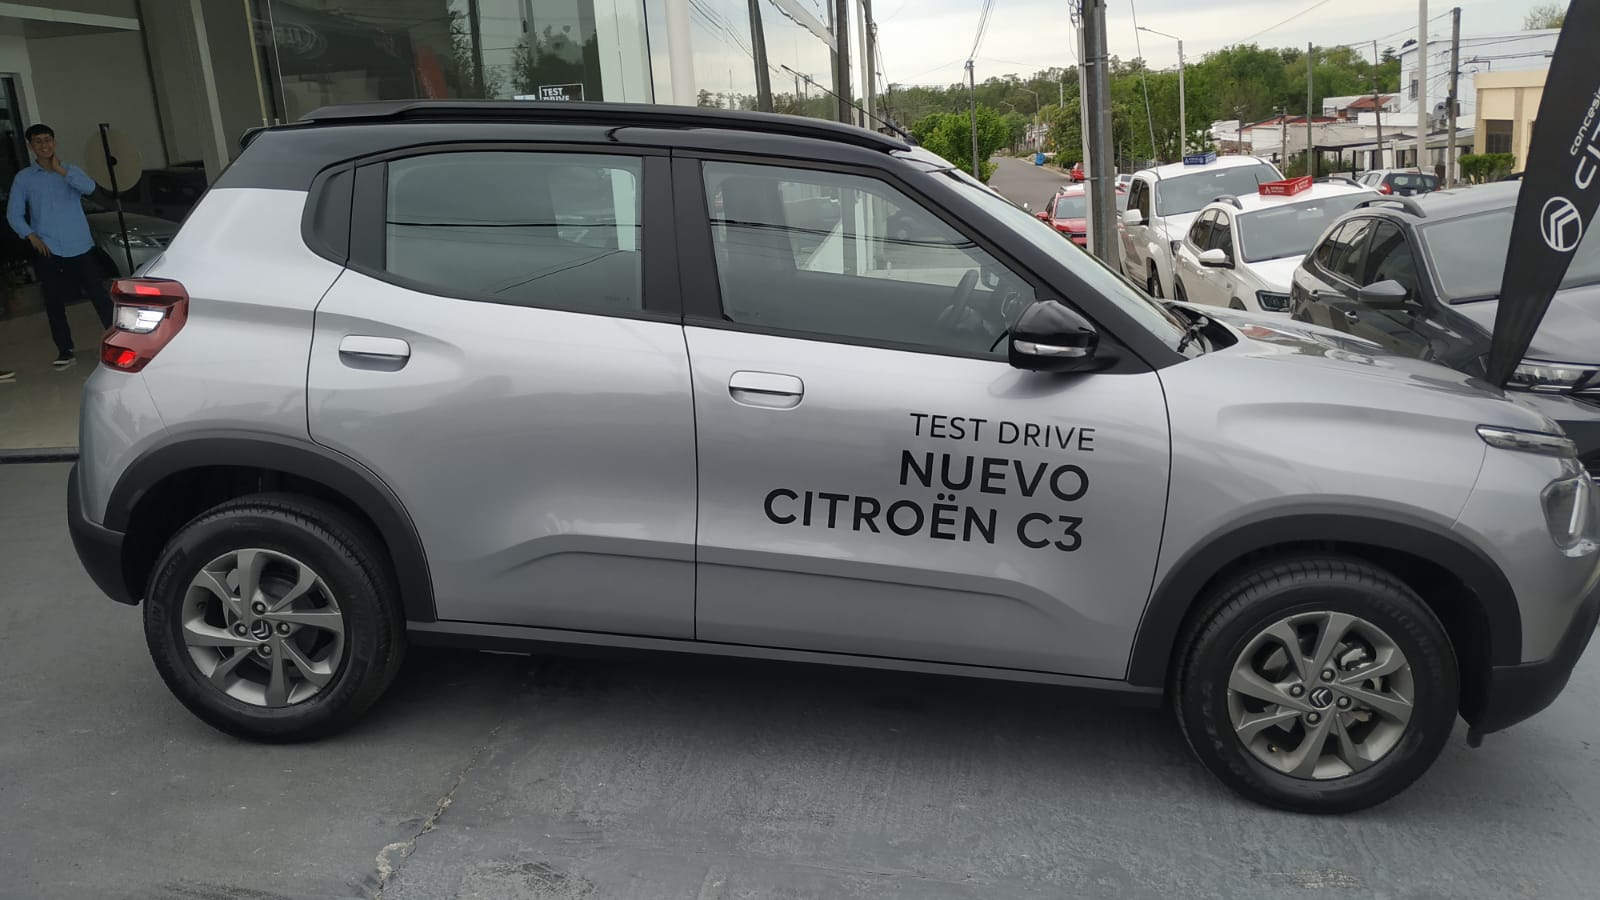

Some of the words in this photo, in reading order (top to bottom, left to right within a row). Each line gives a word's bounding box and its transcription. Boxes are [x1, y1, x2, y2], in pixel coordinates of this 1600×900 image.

[542, 87, 563, 97] TEST
[909, 413, 988, 442] TEST
[998, 421, 1096, 451] DRIVE
[899, 450, 1089, 502] NUEVO
[763, 488, 998, 544] CITROËN
[1016, 512, 1084, 552] C3
